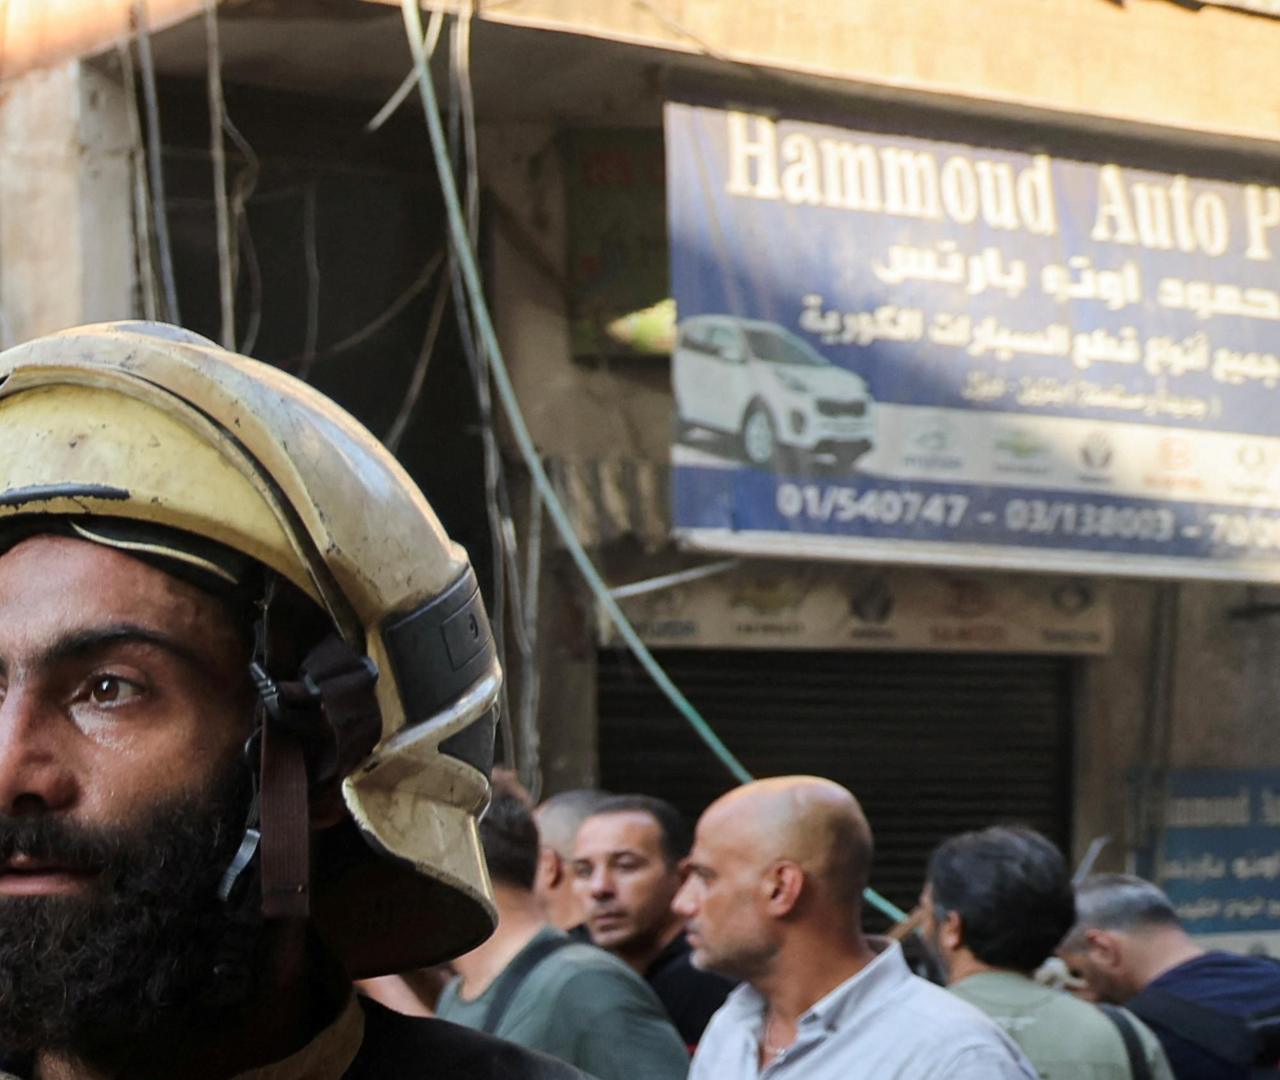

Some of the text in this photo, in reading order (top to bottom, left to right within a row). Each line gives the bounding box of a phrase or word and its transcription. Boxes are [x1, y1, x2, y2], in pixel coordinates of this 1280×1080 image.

[724, 111, 1057, 236] Hammoud
[1090, 164, 1230, 257] Auto
[776, 483, 970, 528] 01/540747
